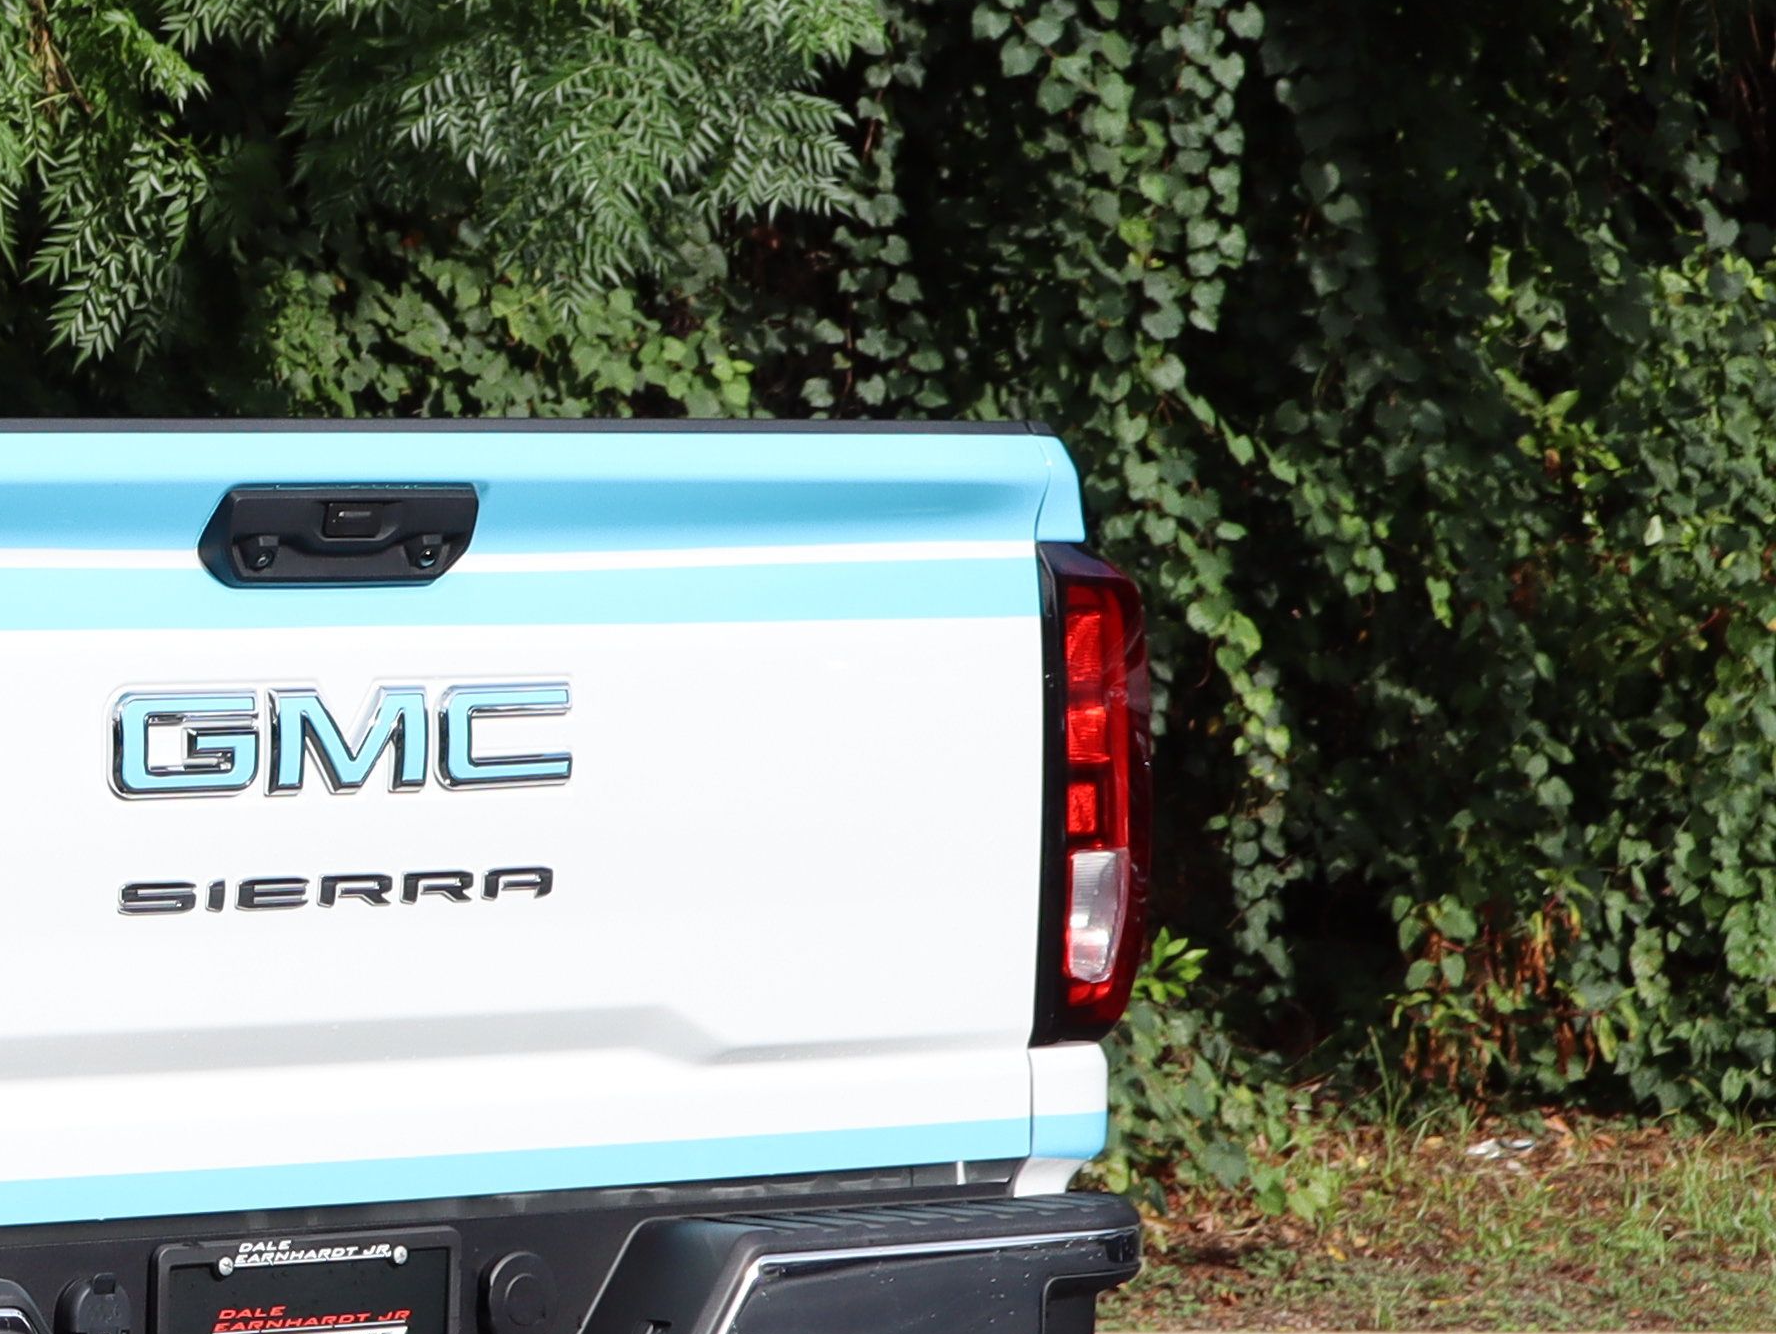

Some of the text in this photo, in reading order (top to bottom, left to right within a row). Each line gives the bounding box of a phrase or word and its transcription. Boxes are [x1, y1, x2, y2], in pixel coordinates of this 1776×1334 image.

[108, 679, 573, 799] GMC
[117, 865, 554, 915] SIERRA
[234, 1246, 359, 1265] EARNHARDT
[238, 1240, 292, 1253] DALE
[213, 1310, 411, 1332] EARNHARDT JR
[218, 1306, 287, 1320] DALE
